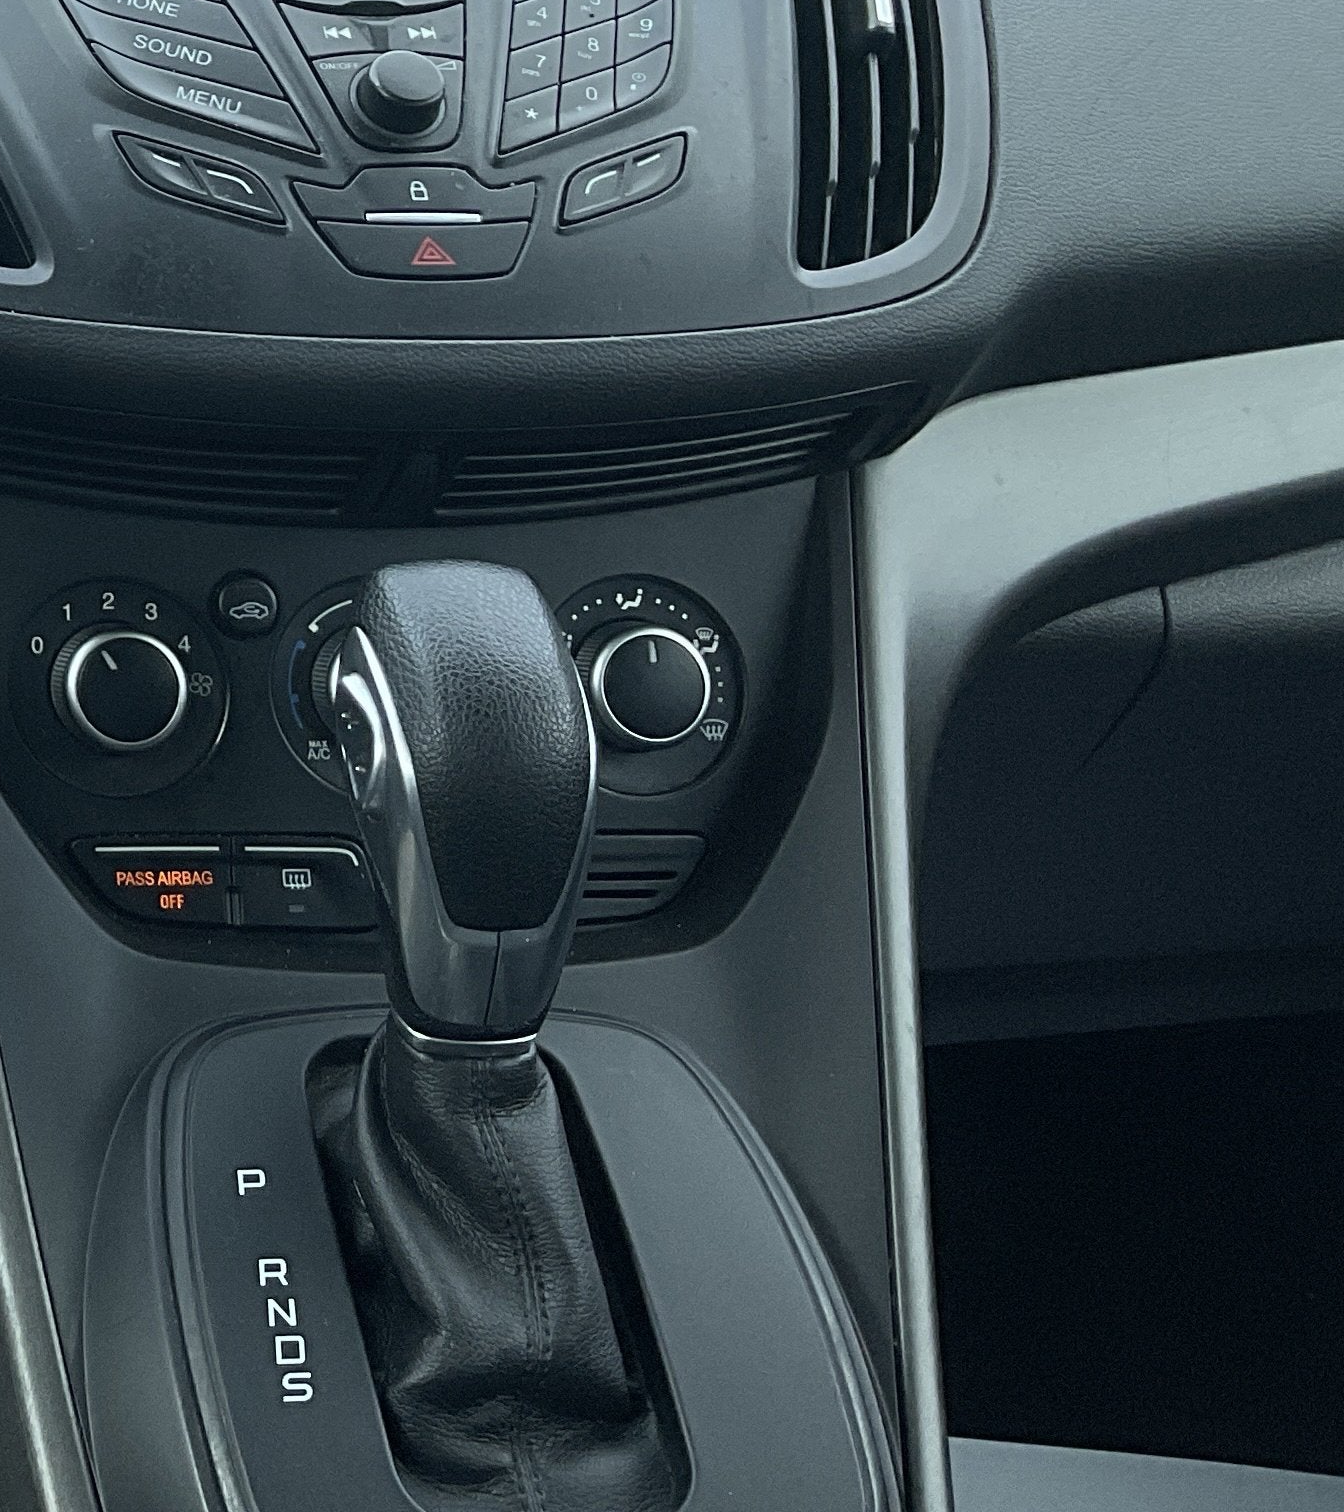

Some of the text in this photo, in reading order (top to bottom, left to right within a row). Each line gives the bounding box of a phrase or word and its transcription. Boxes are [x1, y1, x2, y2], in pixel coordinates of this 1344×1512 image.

[536, 6, 548, 20] 4
[640, 18, 653, 32] 9
[133, 34, 213, 66] SOUND
[587, 37, 600, 52] 8
[535, 54, 547, 68] 7
[175, 85, 243, 115] MENU
[585, 86, 598, 100] 0
[101, 592, 115, 610] 2
[62, 603, 72, 621] 1
[144, 603, 158, 620] 3
[30, 636, 44, 654] 0
[177, 635, 191, 653] 4
[307, 748, 331, 760] A/C
[116, 871, 213, 887] PASS AIRBAG
[159, 894, 185, 909] OFF
[237, 1168, 266, 1196] P
[258, 1258, 289, 1286] R
[267, 1298, 297, 1327] N
[274, 1335, 306, 1365] D
[281, 1371, 314, 1402] S
